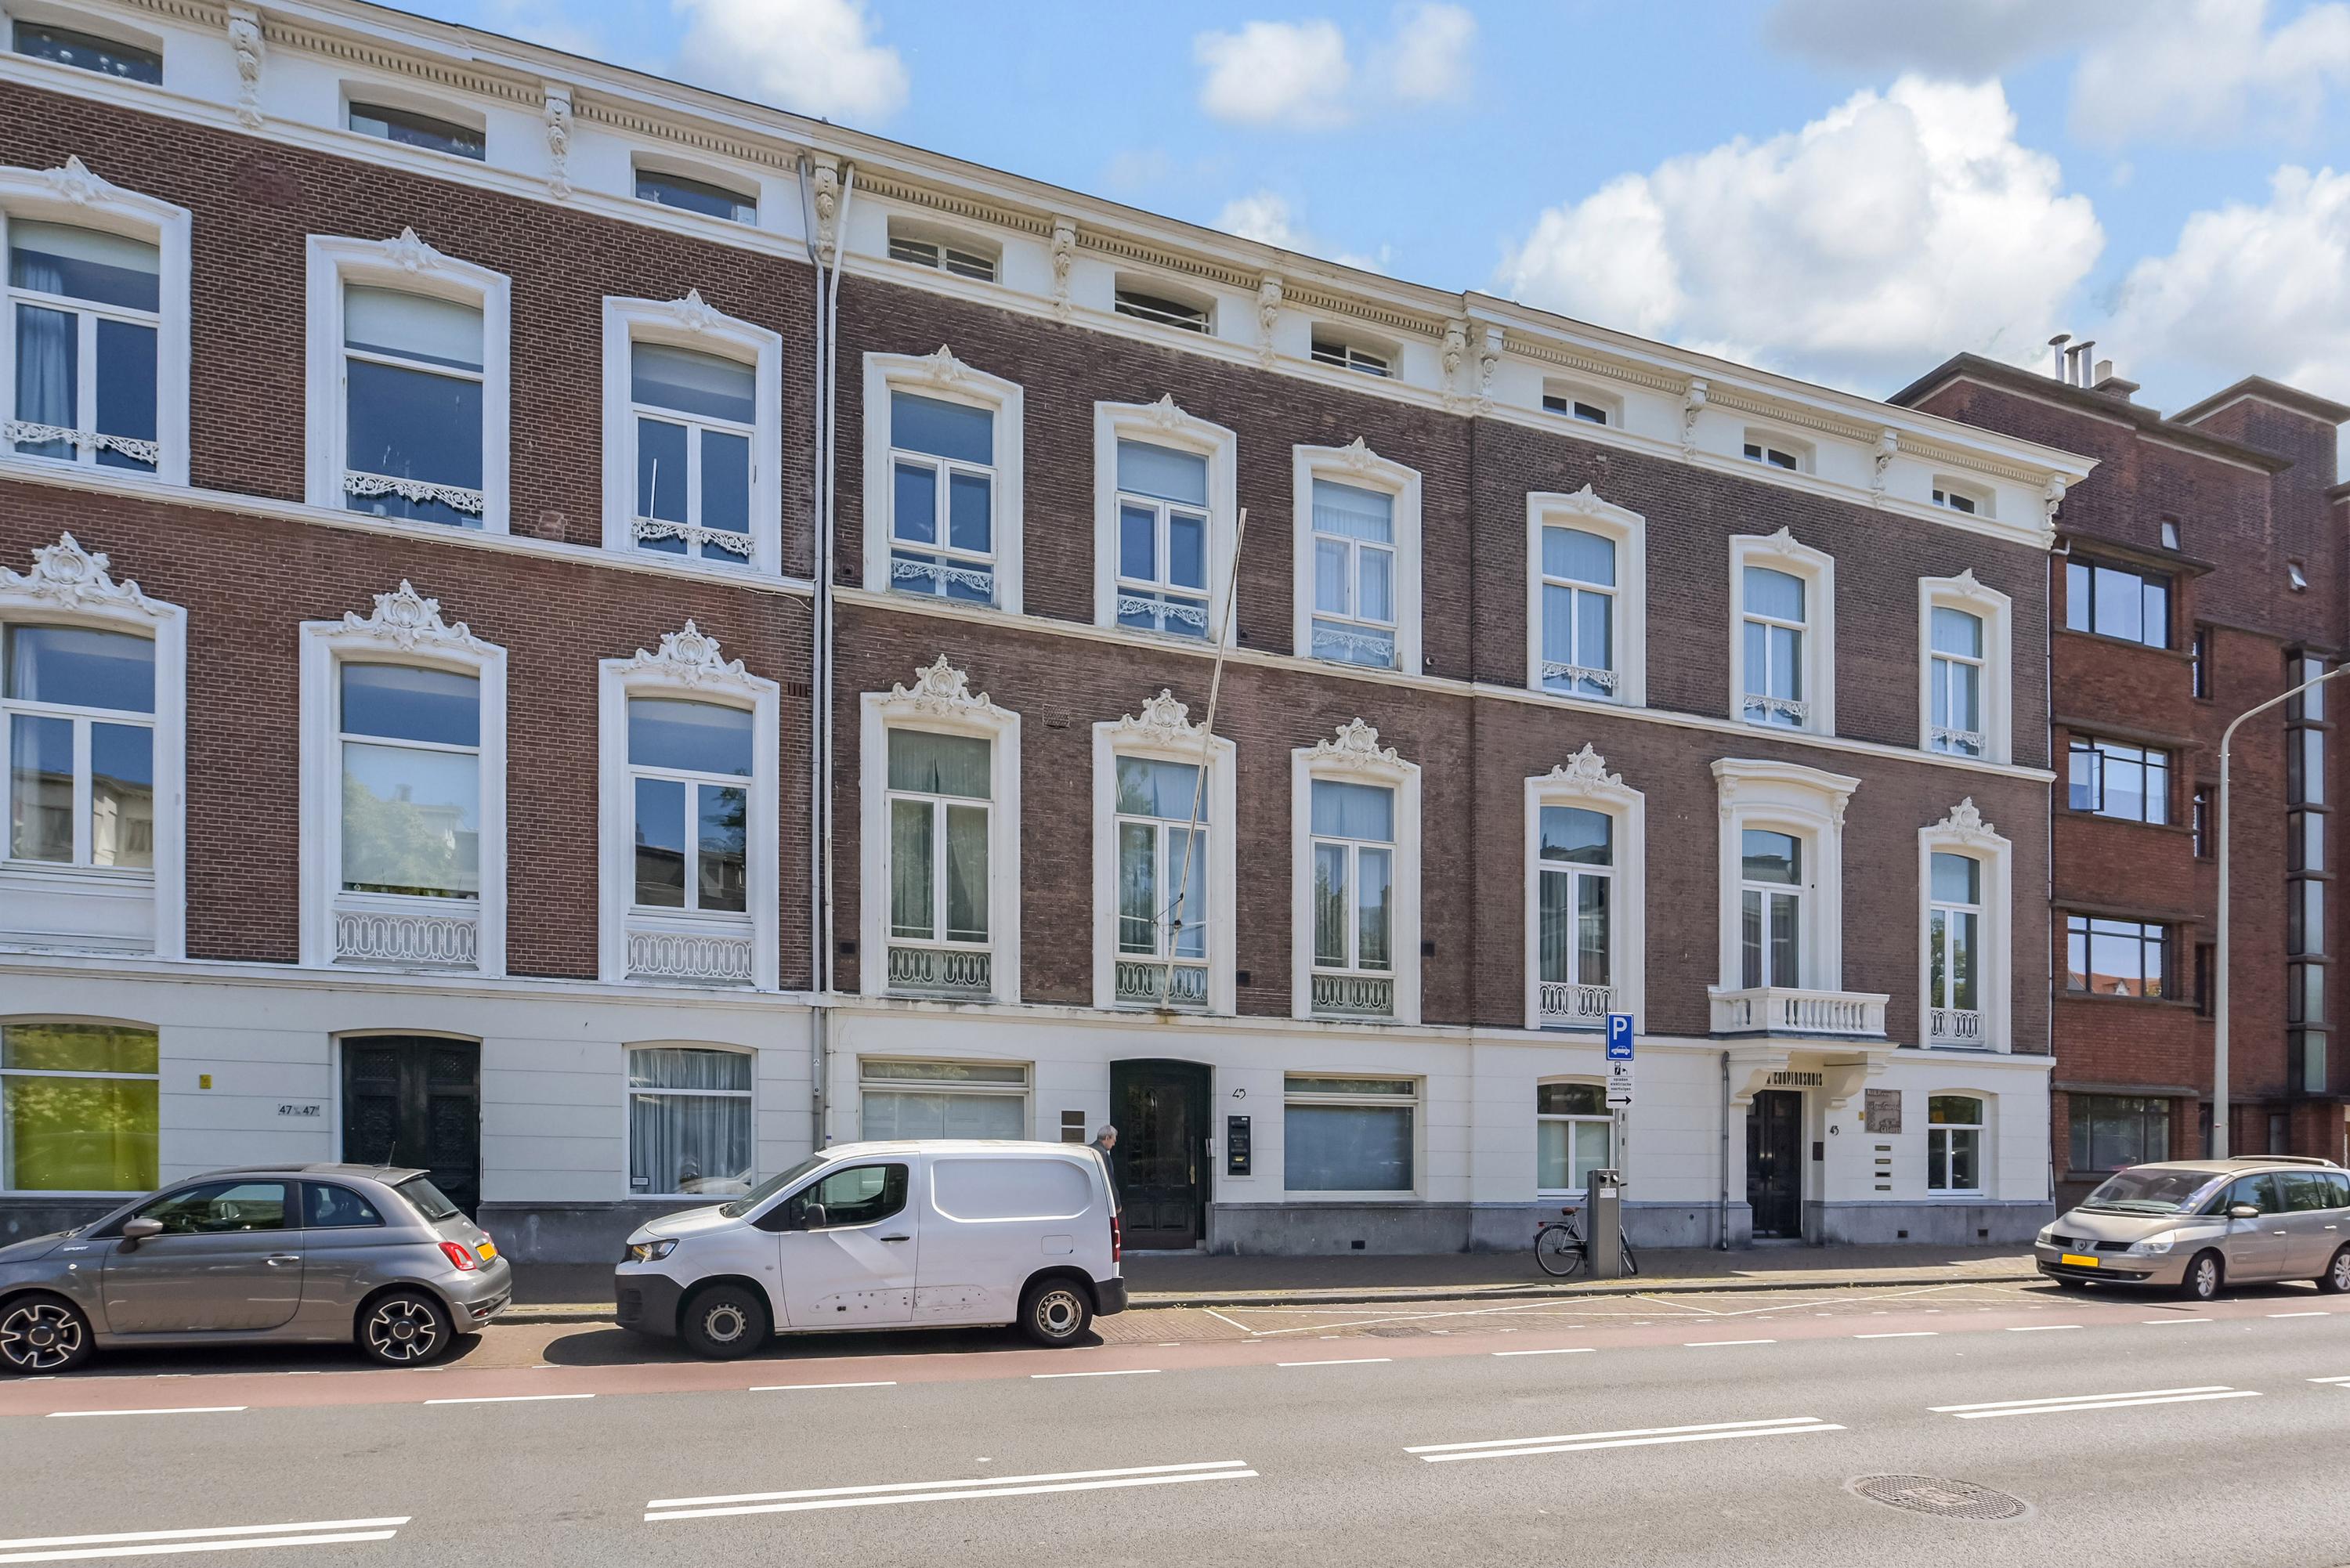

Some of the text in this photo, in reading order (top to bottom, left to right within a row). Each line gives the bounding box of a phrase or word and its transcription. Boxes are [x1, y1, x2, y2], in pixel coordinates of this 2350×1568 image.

[1614, 1017, 1627, 1040] P
[1232, 1089, 1246, 1100] 45
[279, 1105, 292, 1115] 47
